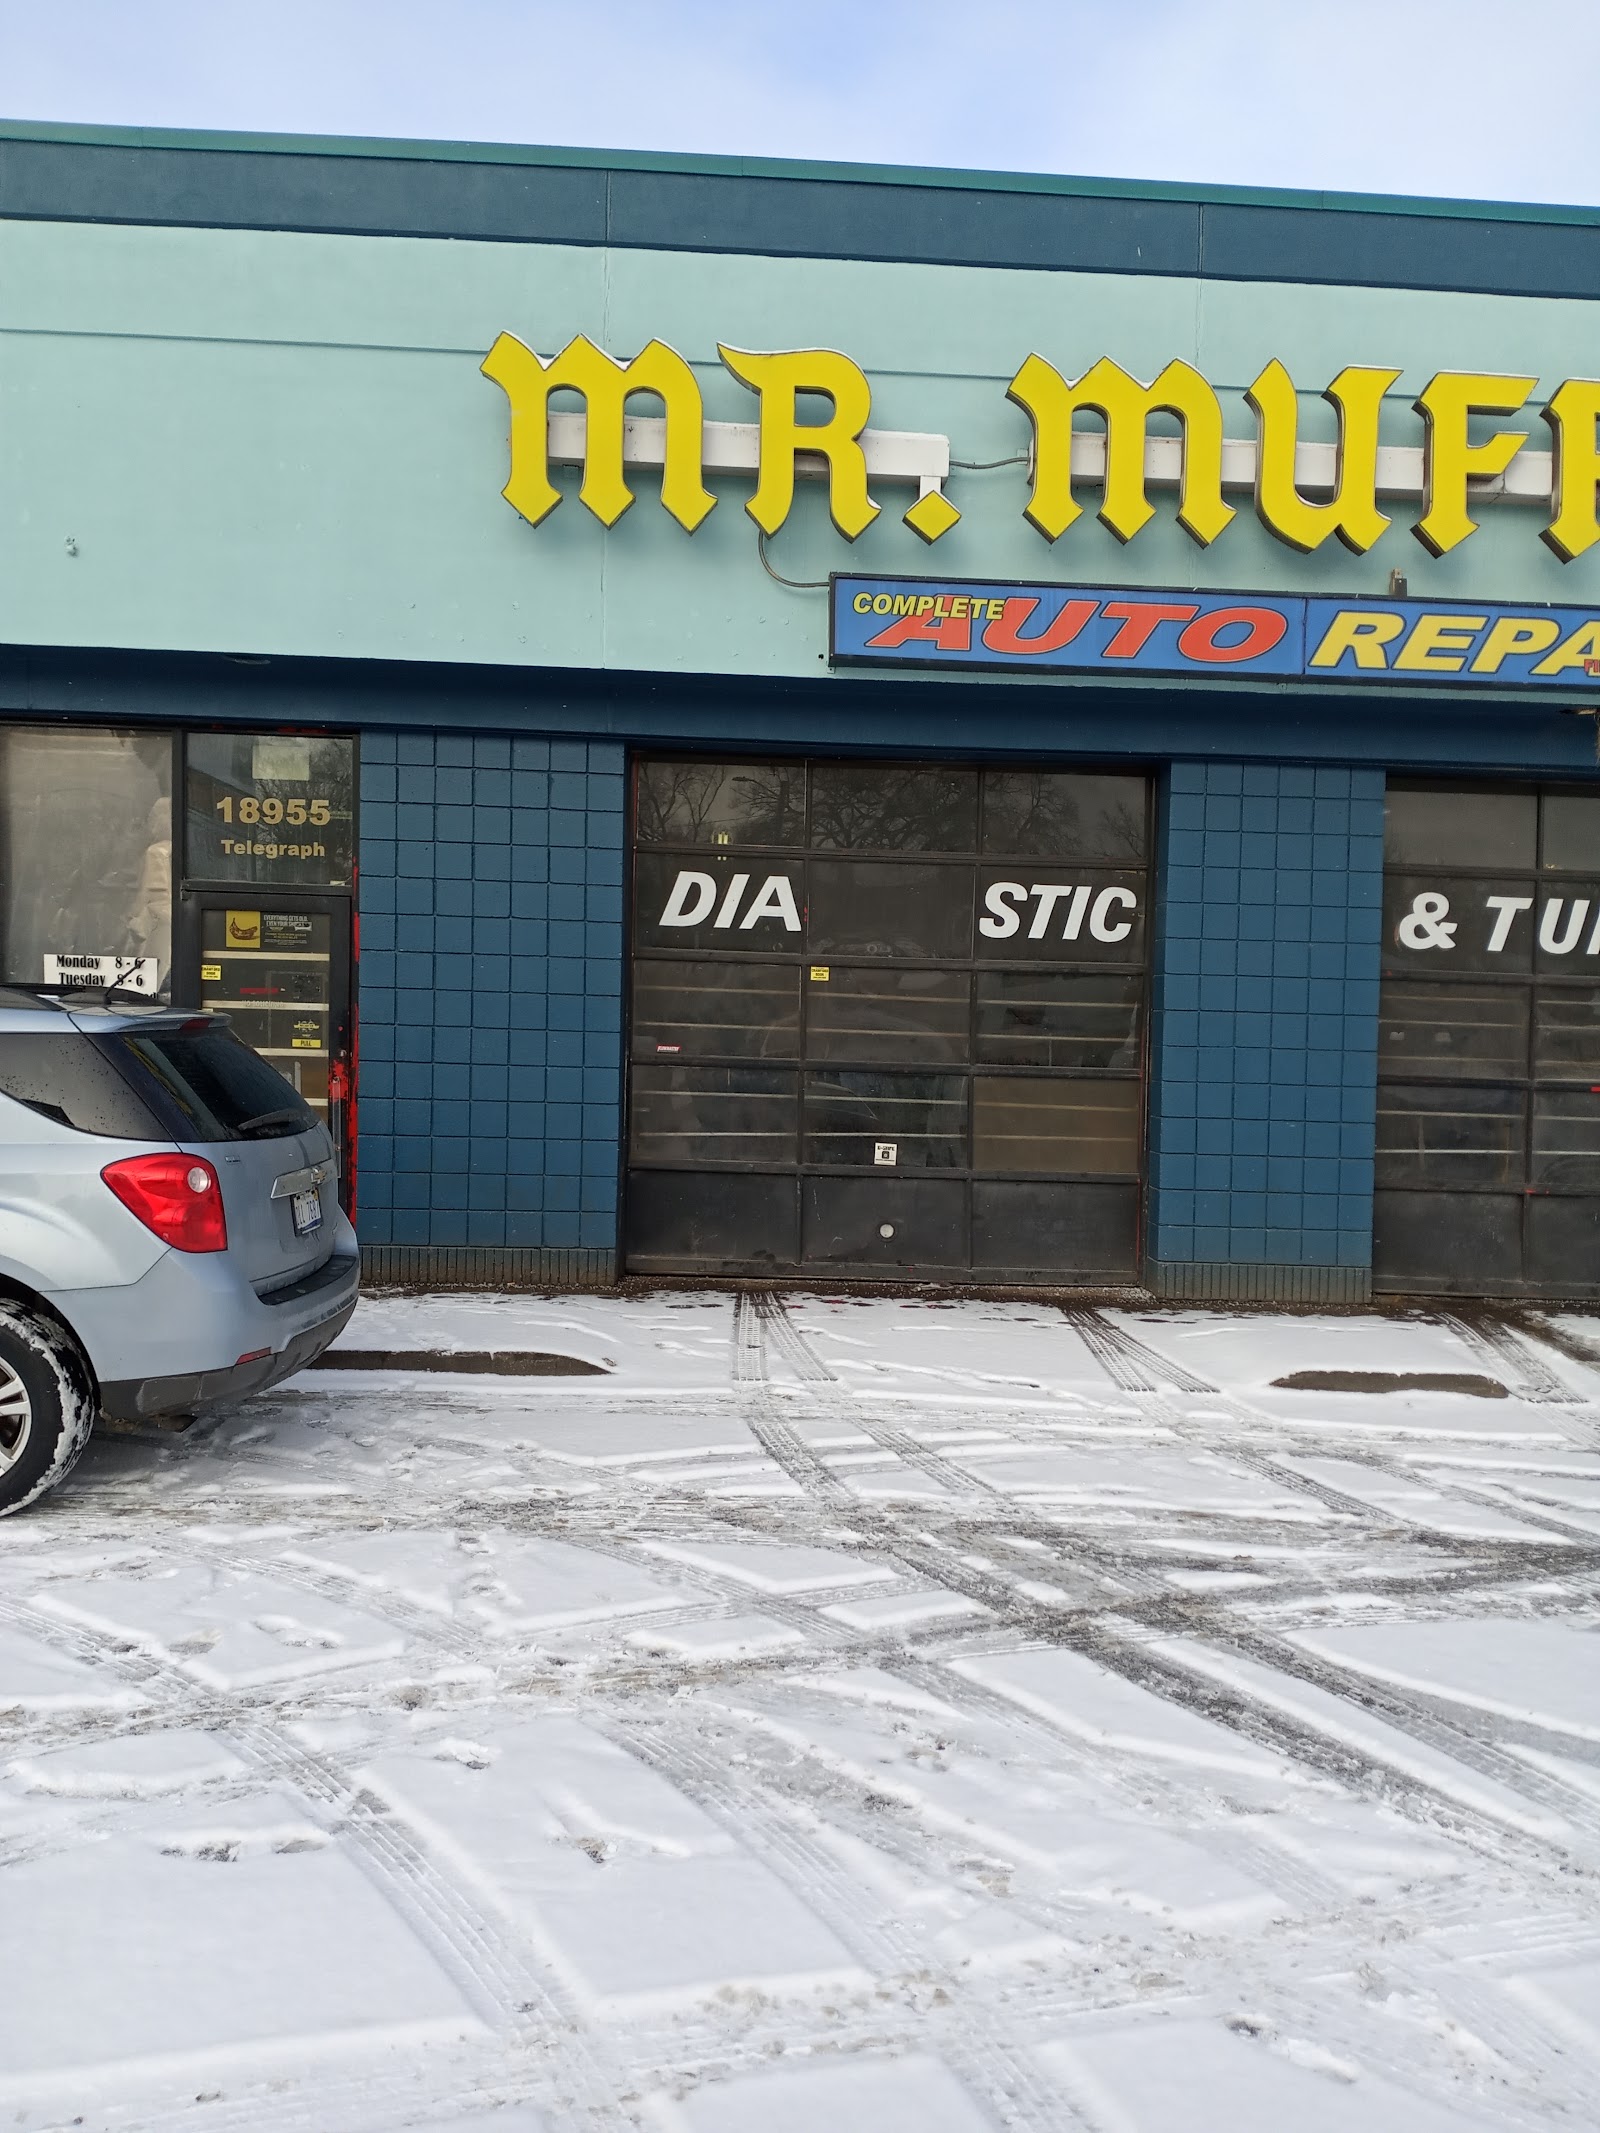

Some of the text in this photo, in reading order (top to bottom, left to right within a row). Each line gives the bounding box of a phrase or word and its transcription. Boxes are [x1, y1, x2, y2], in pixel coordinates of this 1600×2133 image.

[480, 330, 961, 543] MR.
[853, 592, 1005, 620] COMPLETE
[864, 593, 1600, 678] AUTO REPA
[216, 796, 331, 825] 18955
[221, 840, 325, 860] Telegraph
[659, 870, 1137, 944] DIA STIC
[1400, 892, 1600, 955] & TU
[56, 955, 101, 969] Monday
[115, 956, 123, 969] 8
[59, 972, 106, 986] Tuesday
[136, 974, 143, 987] 6
